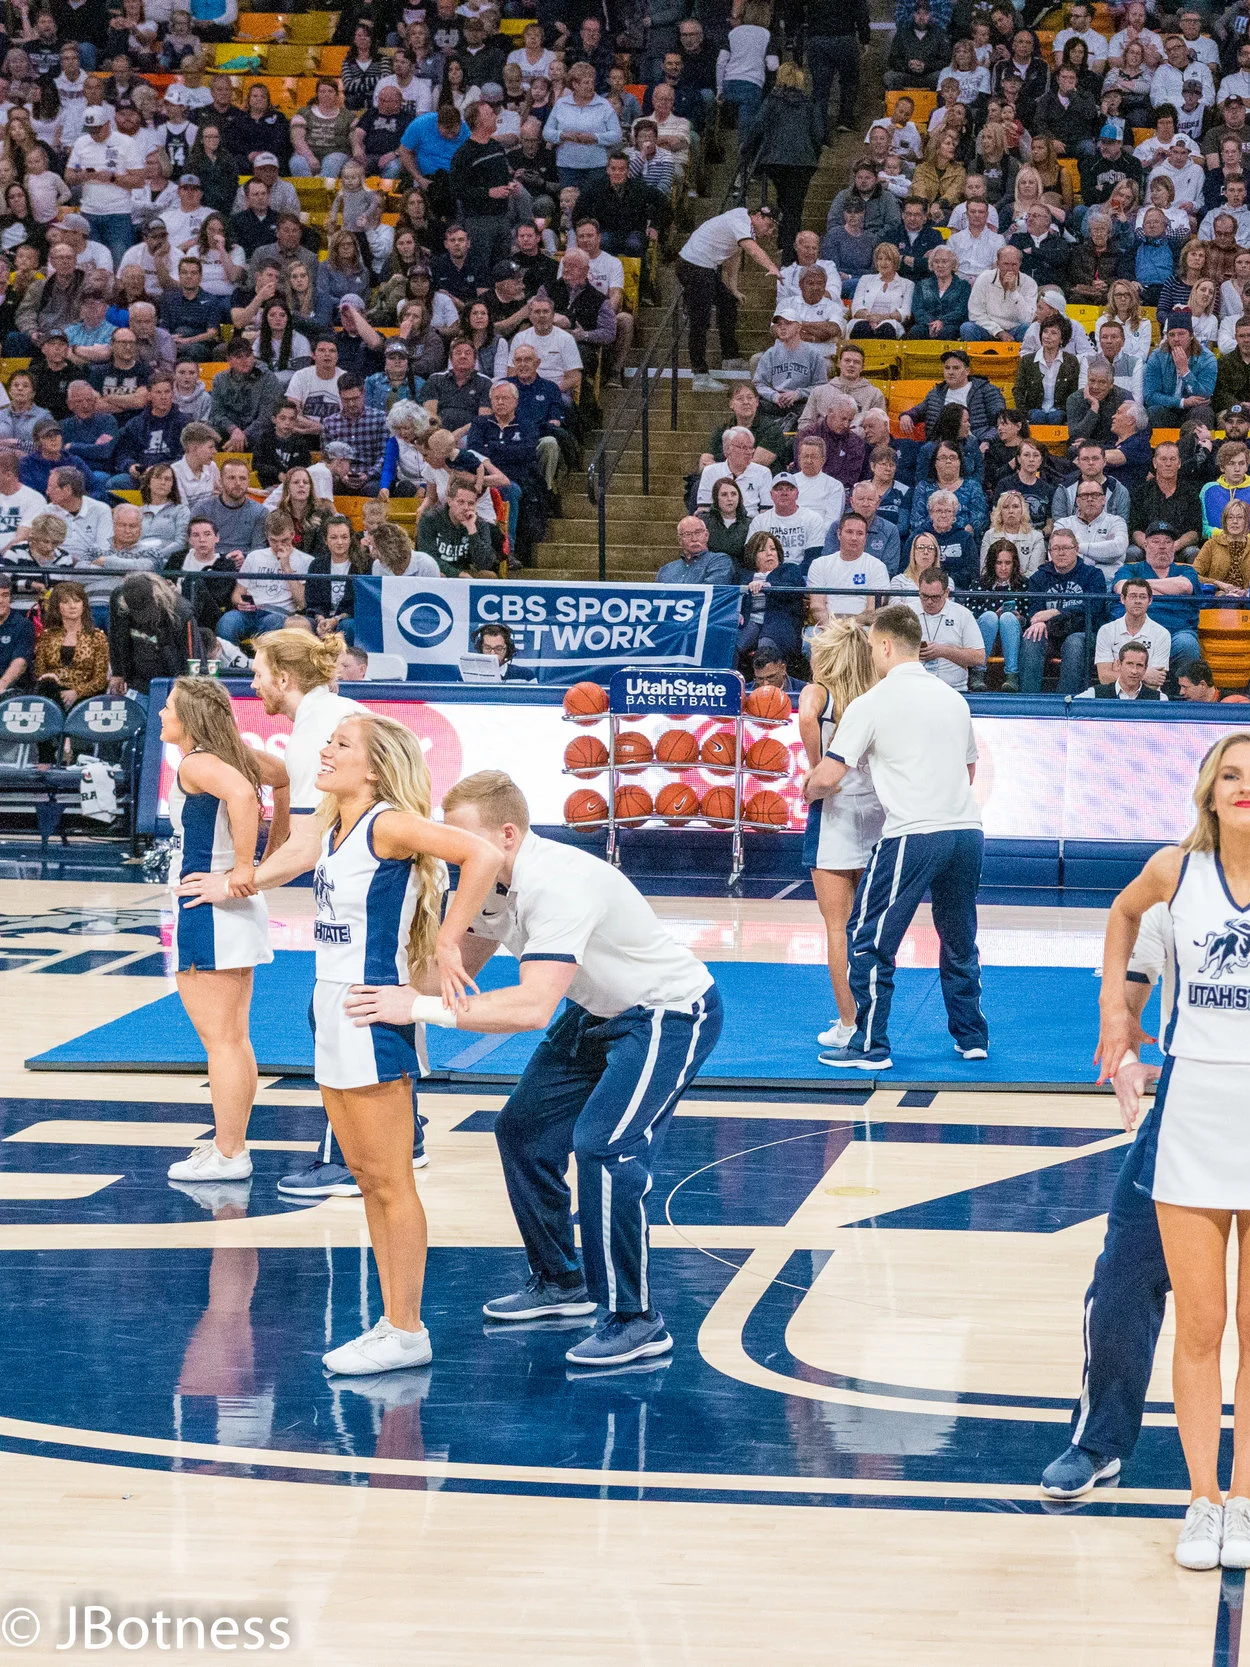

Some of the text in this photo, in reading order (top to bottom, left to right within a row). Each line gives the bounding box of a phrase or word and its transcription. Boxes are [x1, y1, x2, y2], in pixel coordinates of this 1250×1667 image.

[771, 364, 809, 377] UTAH STATE
[477, 594, 695, 623] CBS SPORTS
[508, 623, 660, 651] ETWORK
[626, 679, 727, 697] UtahState
[626, 695, 728, 708] BASKETBALL
